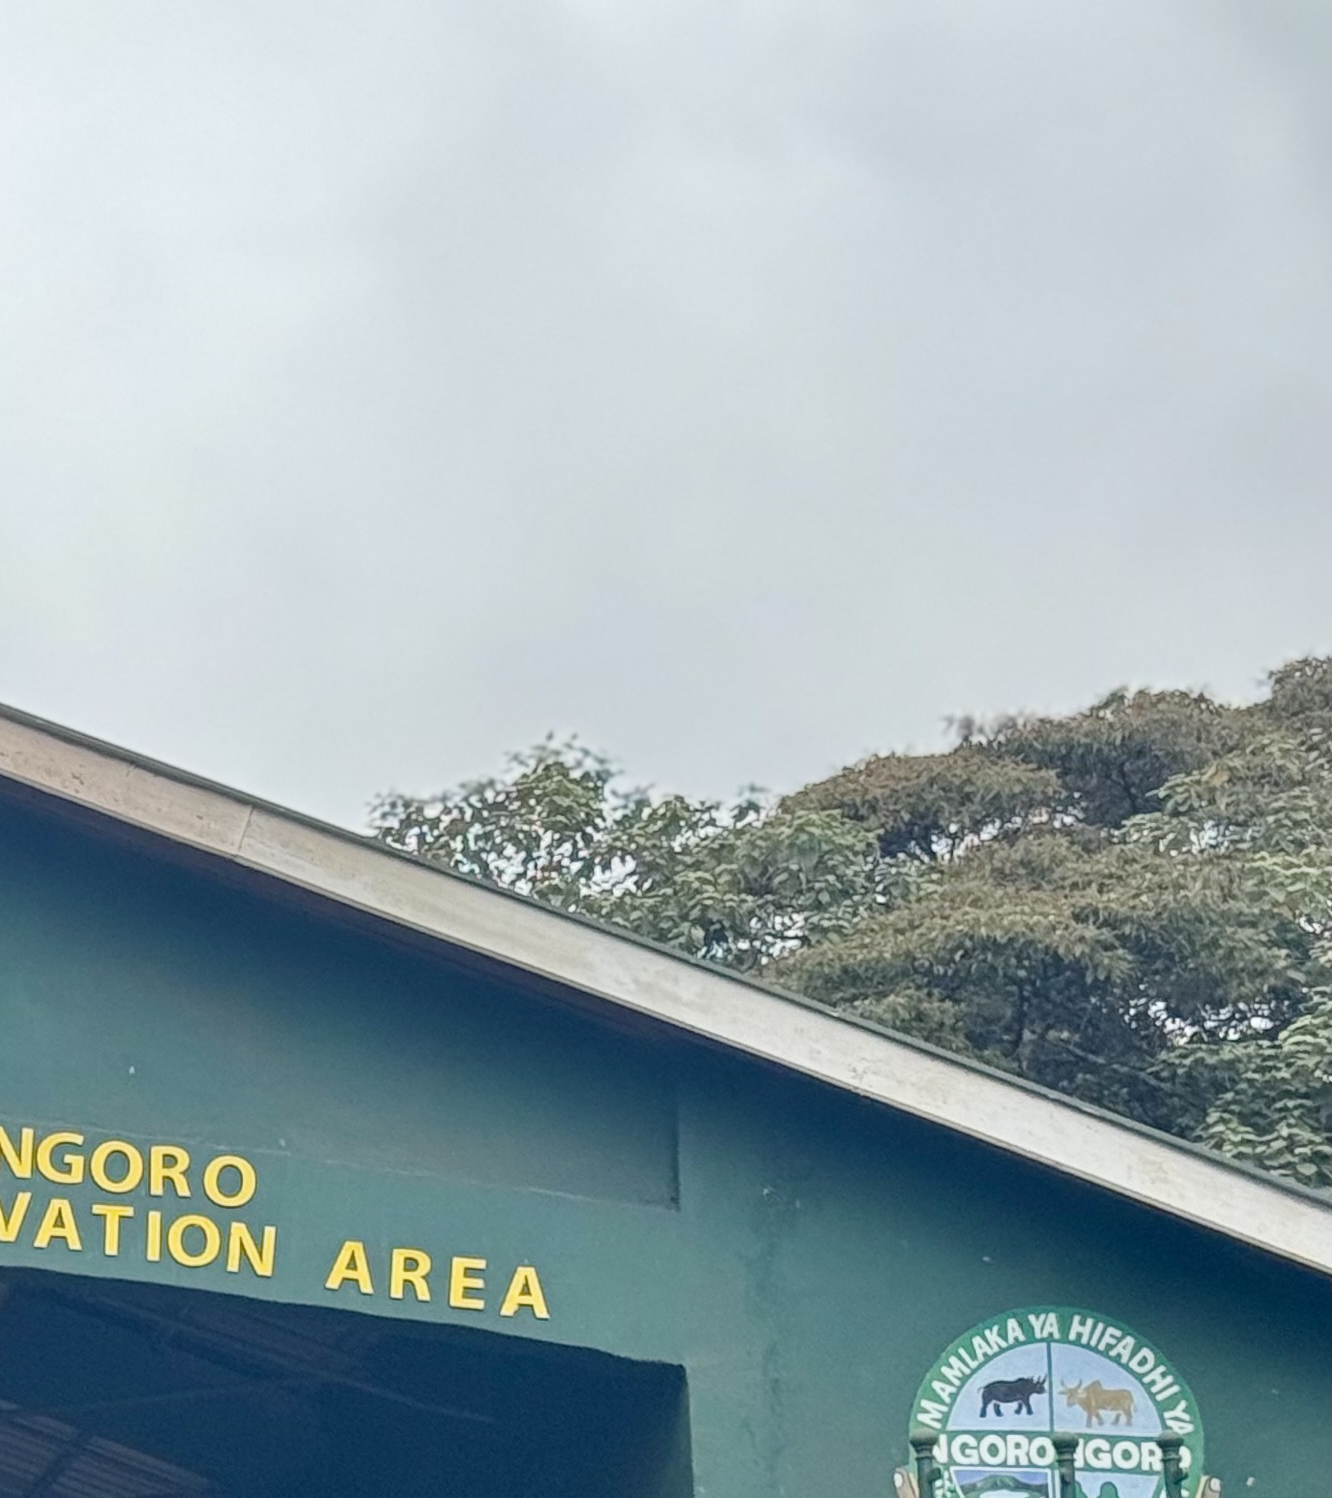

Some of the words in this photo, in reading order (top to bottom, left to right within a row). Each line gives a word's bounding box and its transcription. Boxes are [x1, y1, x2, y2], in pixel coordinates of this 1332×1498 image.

[323, 1240, 551, 1321] AREA
[916, 1313, 1025, 1429] MAMLAKA
[1027, 1312, 1060, 1340] YA
[1068, 1314, 1181, 1404] HIFADHI
[1163, 1399, 1195, 1435] YA
